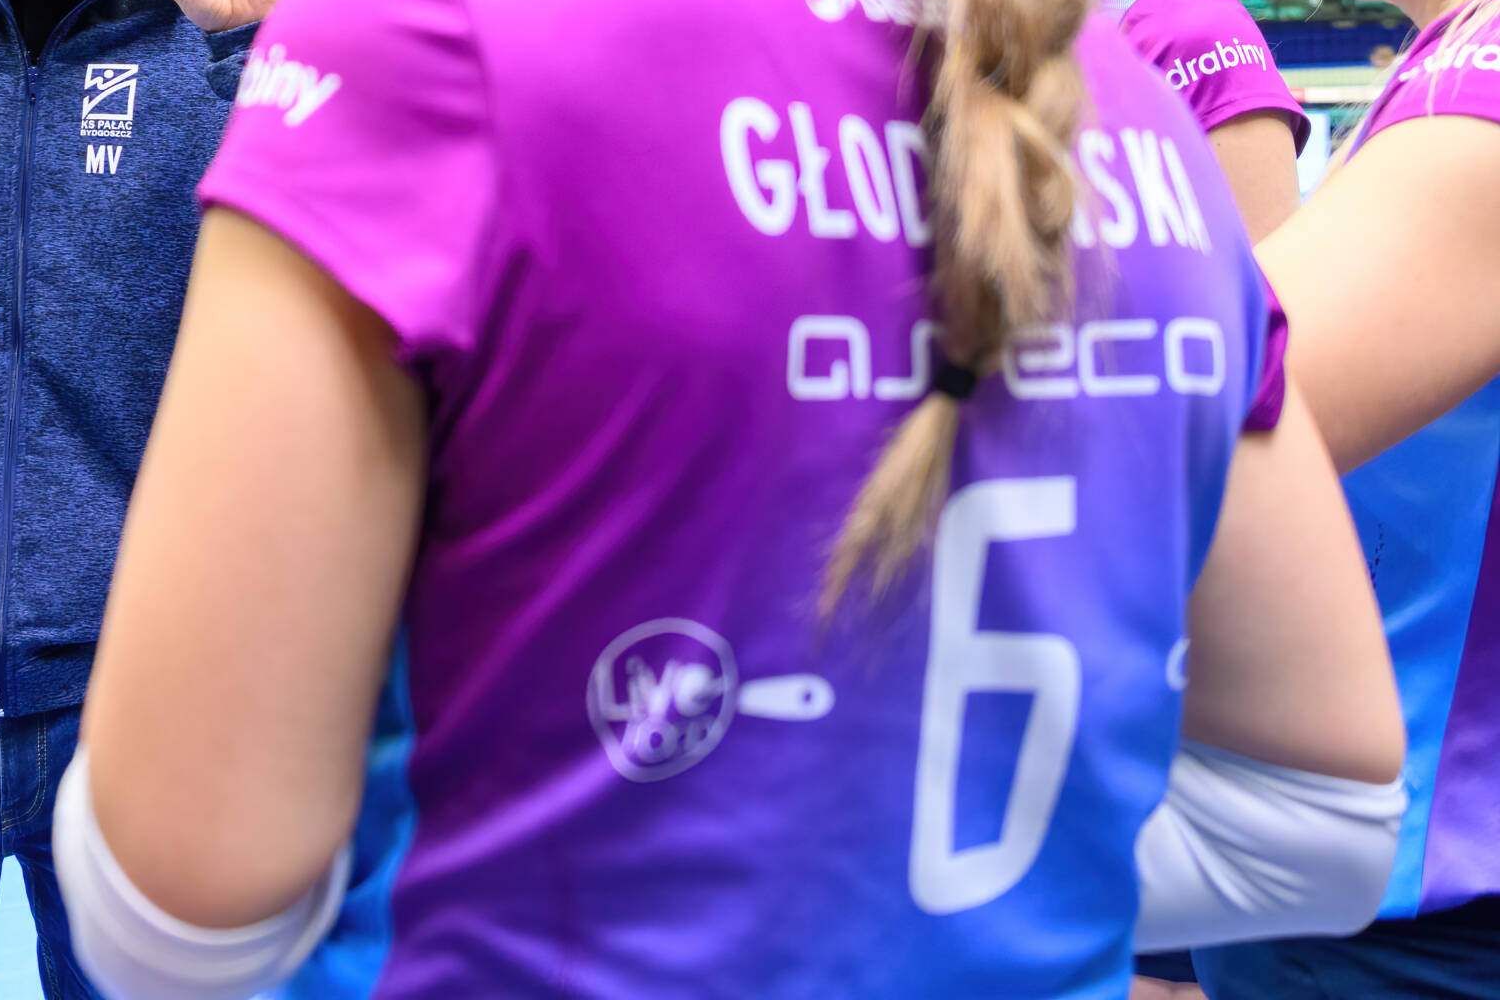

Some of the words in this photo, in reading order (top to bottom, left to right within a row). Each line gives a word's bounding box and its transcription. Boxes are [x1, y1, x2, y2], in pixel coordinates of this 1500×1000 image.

[80, 129, 133, 138] BYDGOSZCZ
[81, 120, 95, 129] KS
[97, 120, 133, 130] PAŁAC
[85, 144, 123, 175] MV
[719, 96, 1212, 254] GŁODSKA
[787, 315, 1226, 401] aseco
[908, 476, 1081, 914] 6
